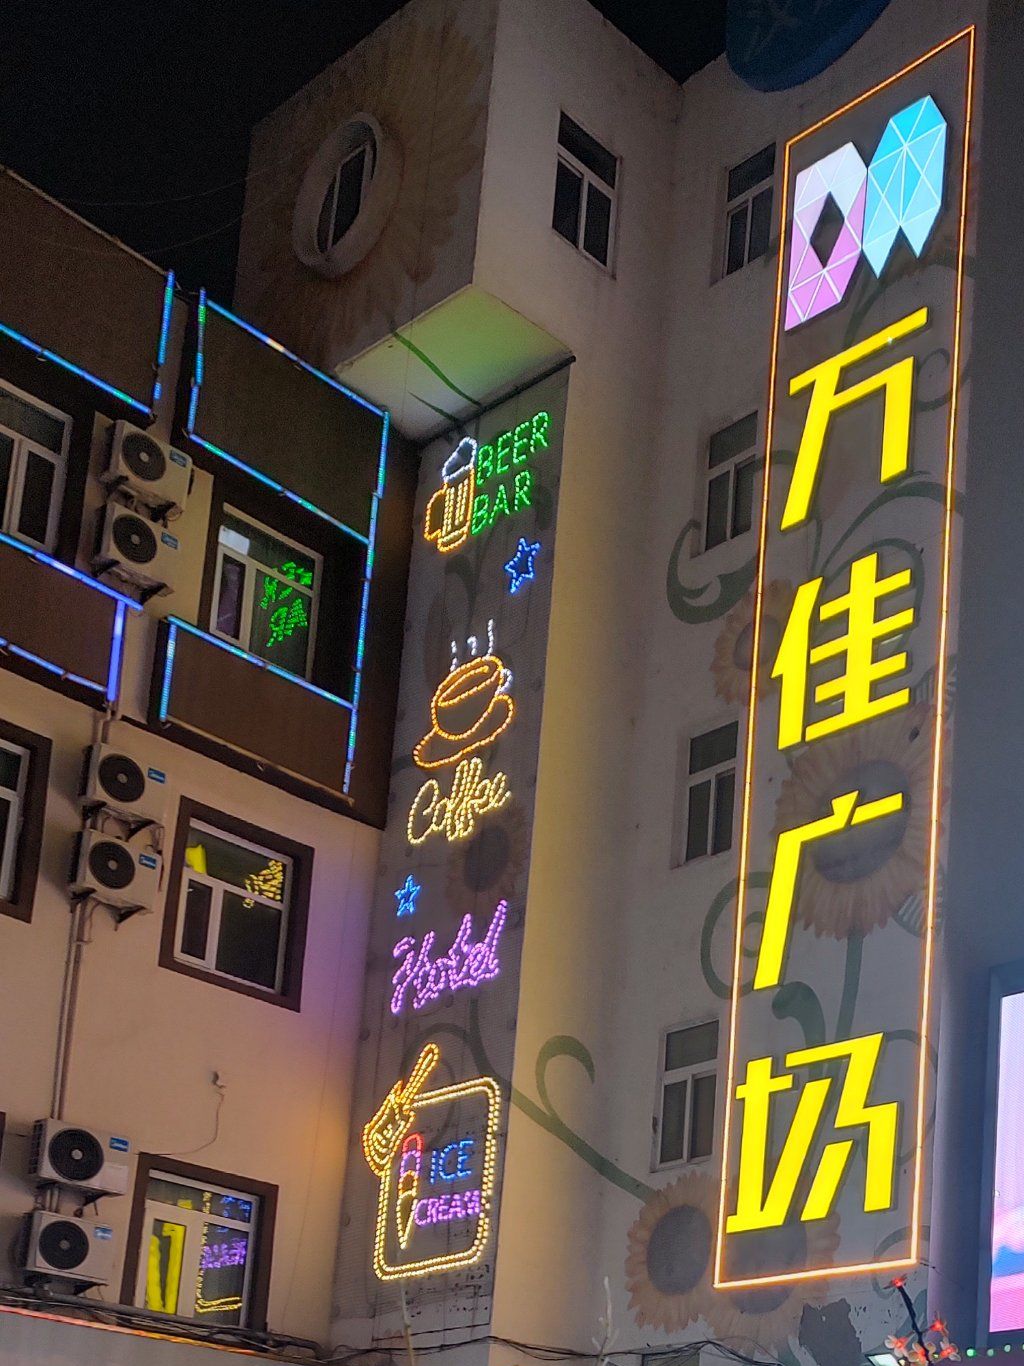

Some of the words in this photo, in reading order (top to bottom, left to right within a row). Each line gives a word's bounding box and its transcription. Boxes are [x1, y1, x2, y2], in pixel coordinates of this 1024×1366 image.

[477, 411, 550, 486] BEER
[471, 470, 533, 535] BAR
[407, 756, 512, 845] Coffee
[727, 306, 929, 1235] 万佳广场
[391, 899, 508, 1014] Hotel
[430, 1140, 474, 1184] ICE
[414, 1189, 482, 1226] CREAM
